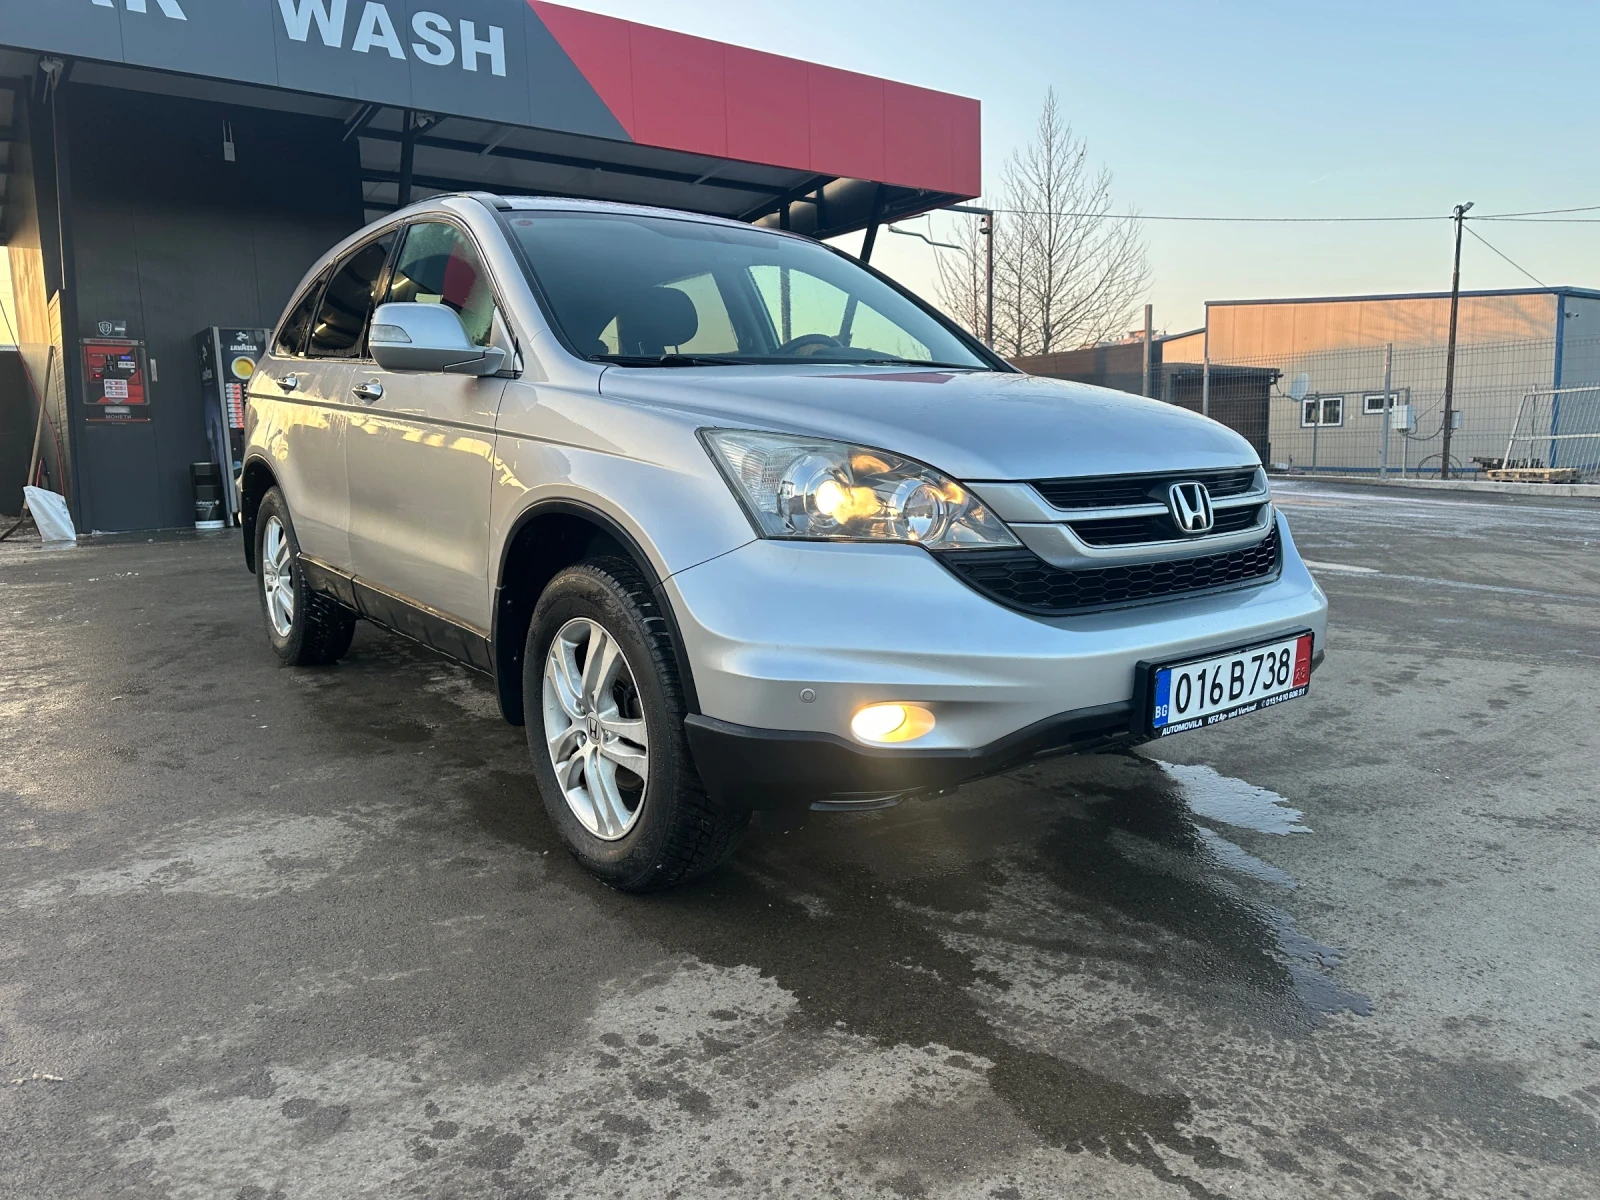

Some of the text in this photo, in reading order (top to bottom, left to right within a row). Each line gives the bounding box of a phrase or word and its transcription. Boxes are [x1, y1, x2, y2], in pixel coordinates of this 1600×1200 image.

[278, 0, 506, 77] WASH
[1155, 704, 1168, 719] BG
[1161, 719, 1203, 736] AUTOMOVILA
[1208, 714, 1219, 724] KFZ
[1228, 708, 1238, 719] und
[1238, 703, 1257, 715] Verkauf
